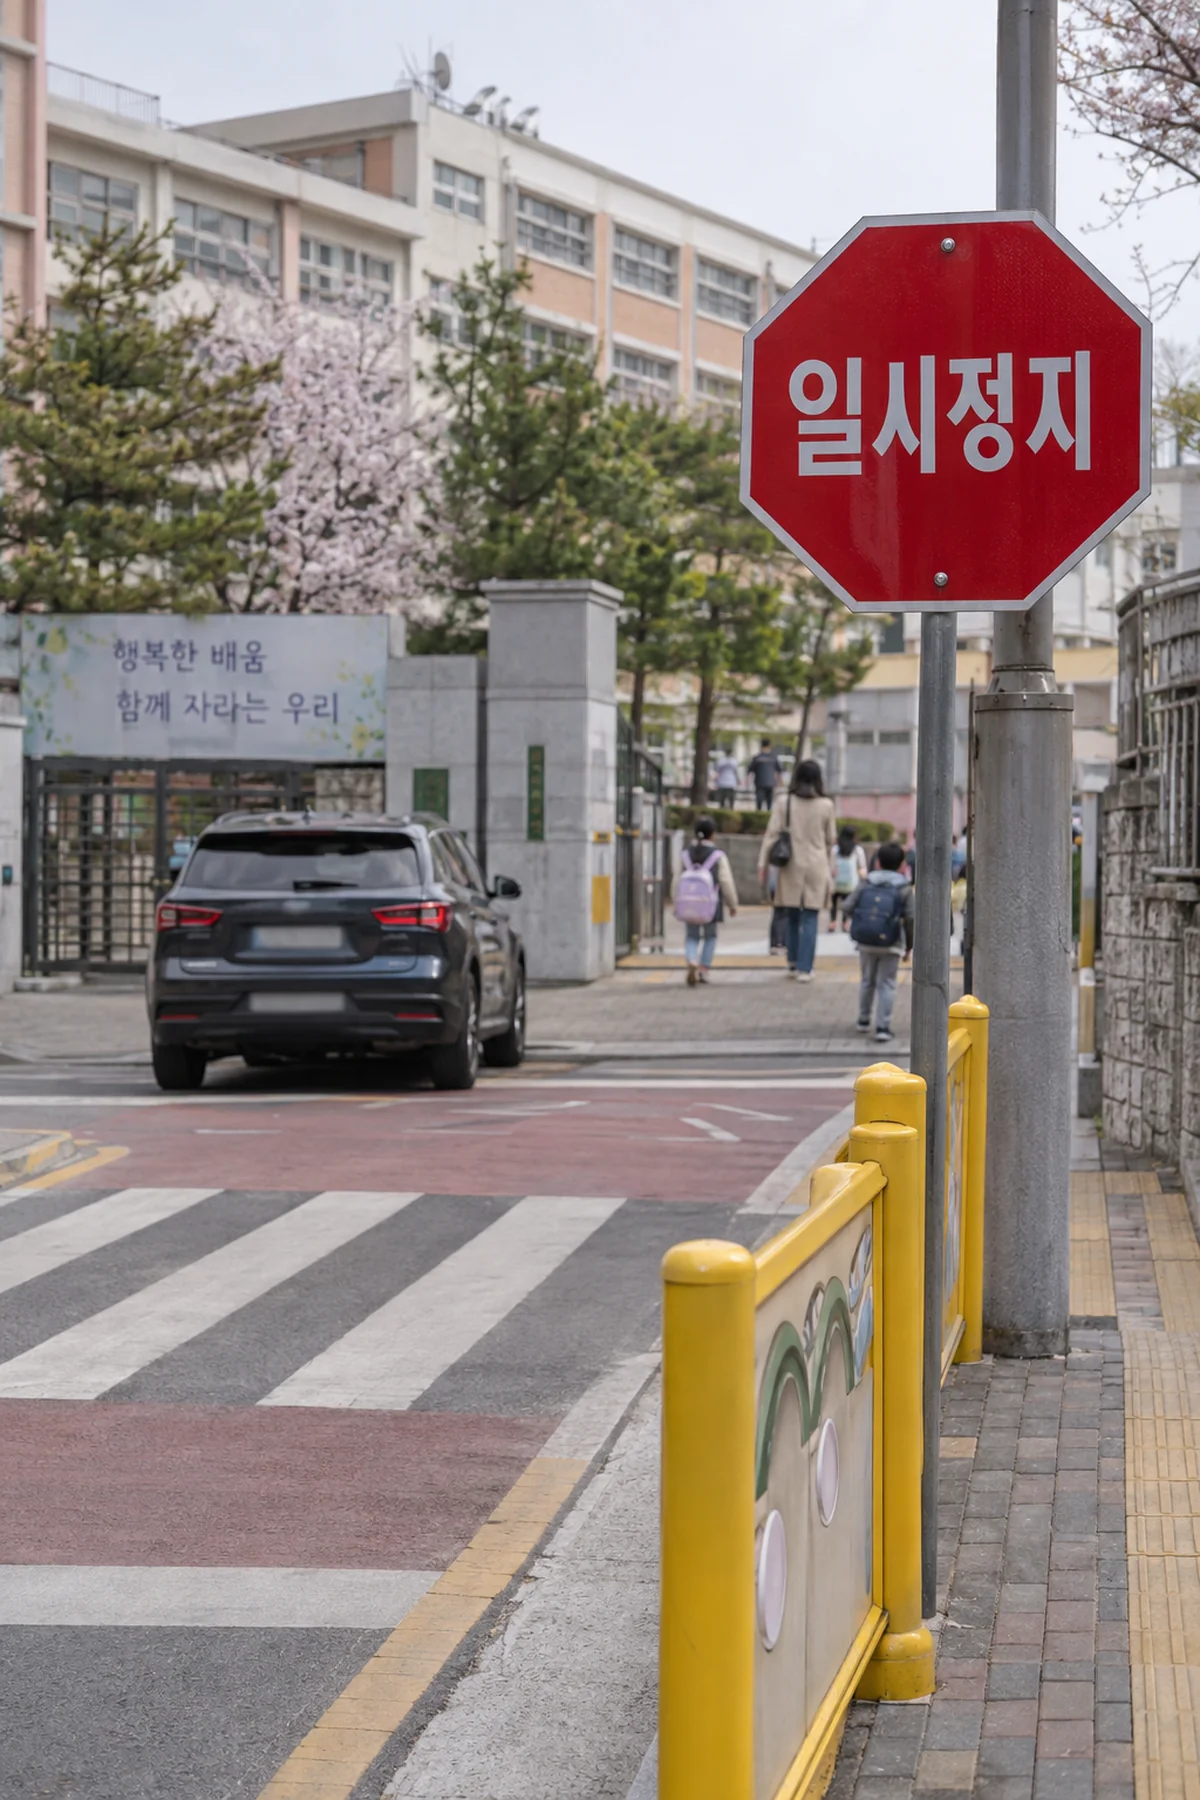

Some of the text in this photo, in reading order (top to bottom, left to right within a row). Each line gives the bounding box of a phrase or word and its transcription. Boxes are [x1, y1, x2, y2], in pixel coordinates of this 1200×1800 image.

[788, 350, 1091, 476] 일시정지
[113, 638, 268, 674] 행복한 배움
[117, 689, 339, 725] 함께 자라는 우리
